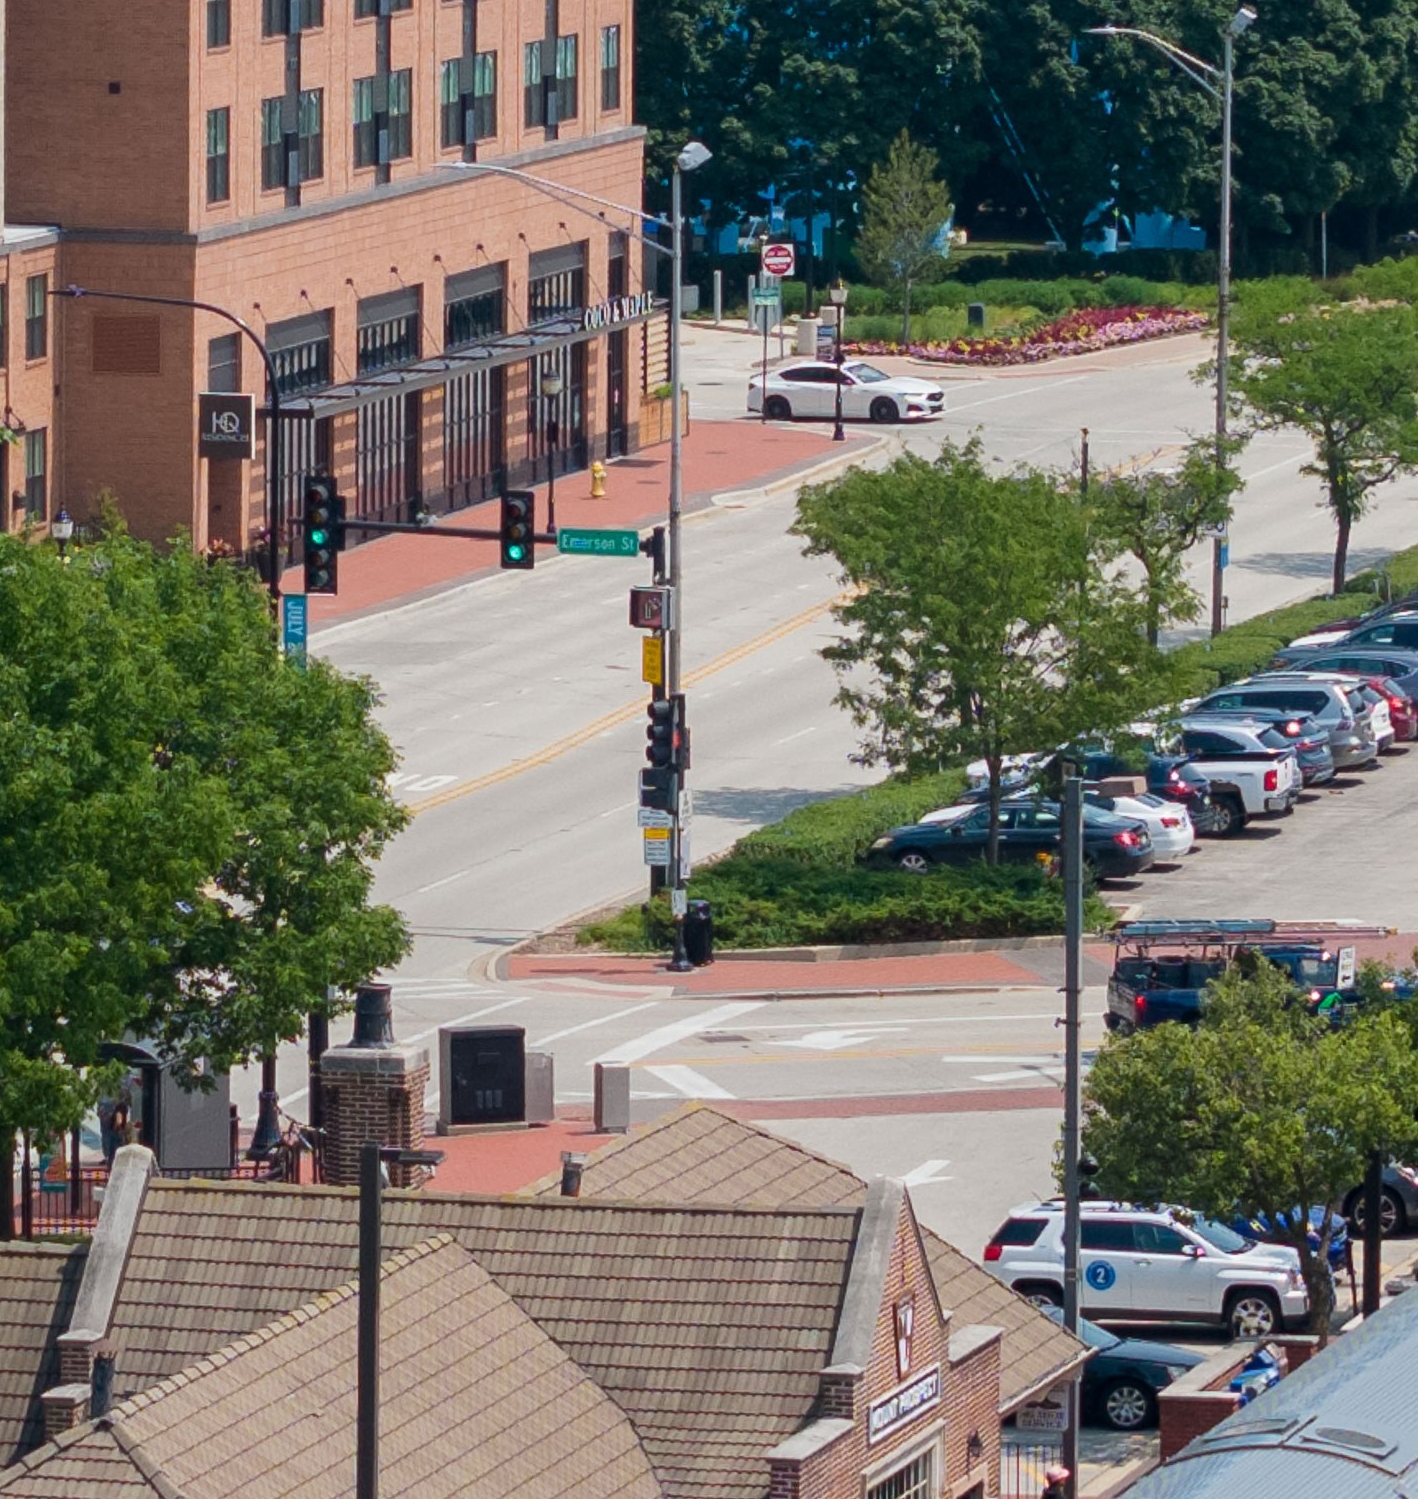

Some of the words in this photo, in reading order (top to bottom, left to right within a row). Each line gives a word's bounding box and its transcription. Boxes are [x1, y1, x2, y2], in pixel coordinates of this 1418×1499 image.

[622, 290, 653, 321] MAPLE
[561, 534, 615, 550] Emerson
[621, 536, 634, 551] St
[287, 601, 304, 636] JULY
[1096, 1267, 1106, 1283] 2
